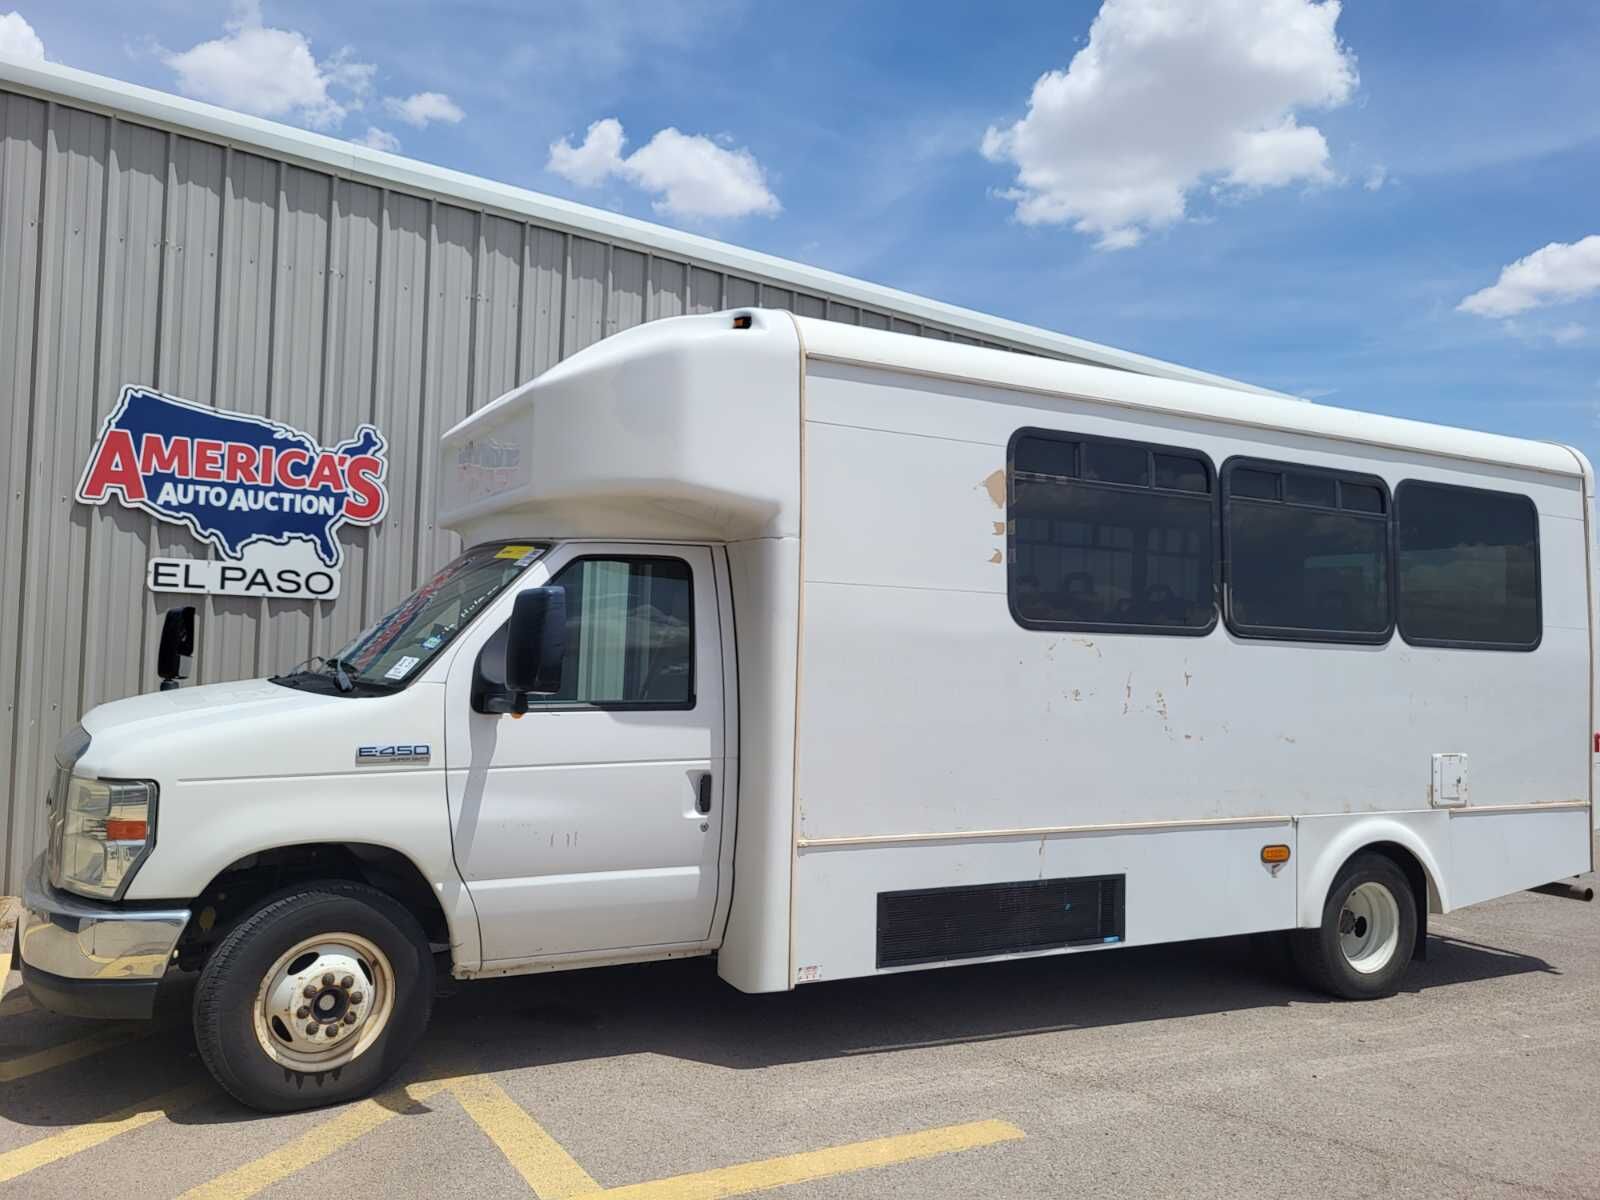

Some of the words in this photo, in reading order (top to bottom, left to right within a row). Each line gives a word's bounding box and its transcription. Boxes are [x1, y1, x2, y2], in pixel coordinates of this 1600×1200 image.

[83, 429, 383, 520] AMERICA'S
[156, 482, 227, 506] AUTO
[228, 489, 335, 516] AUCTION
[153, 562, 205, 588] EL
[219, 566, 334, 595] PASO
